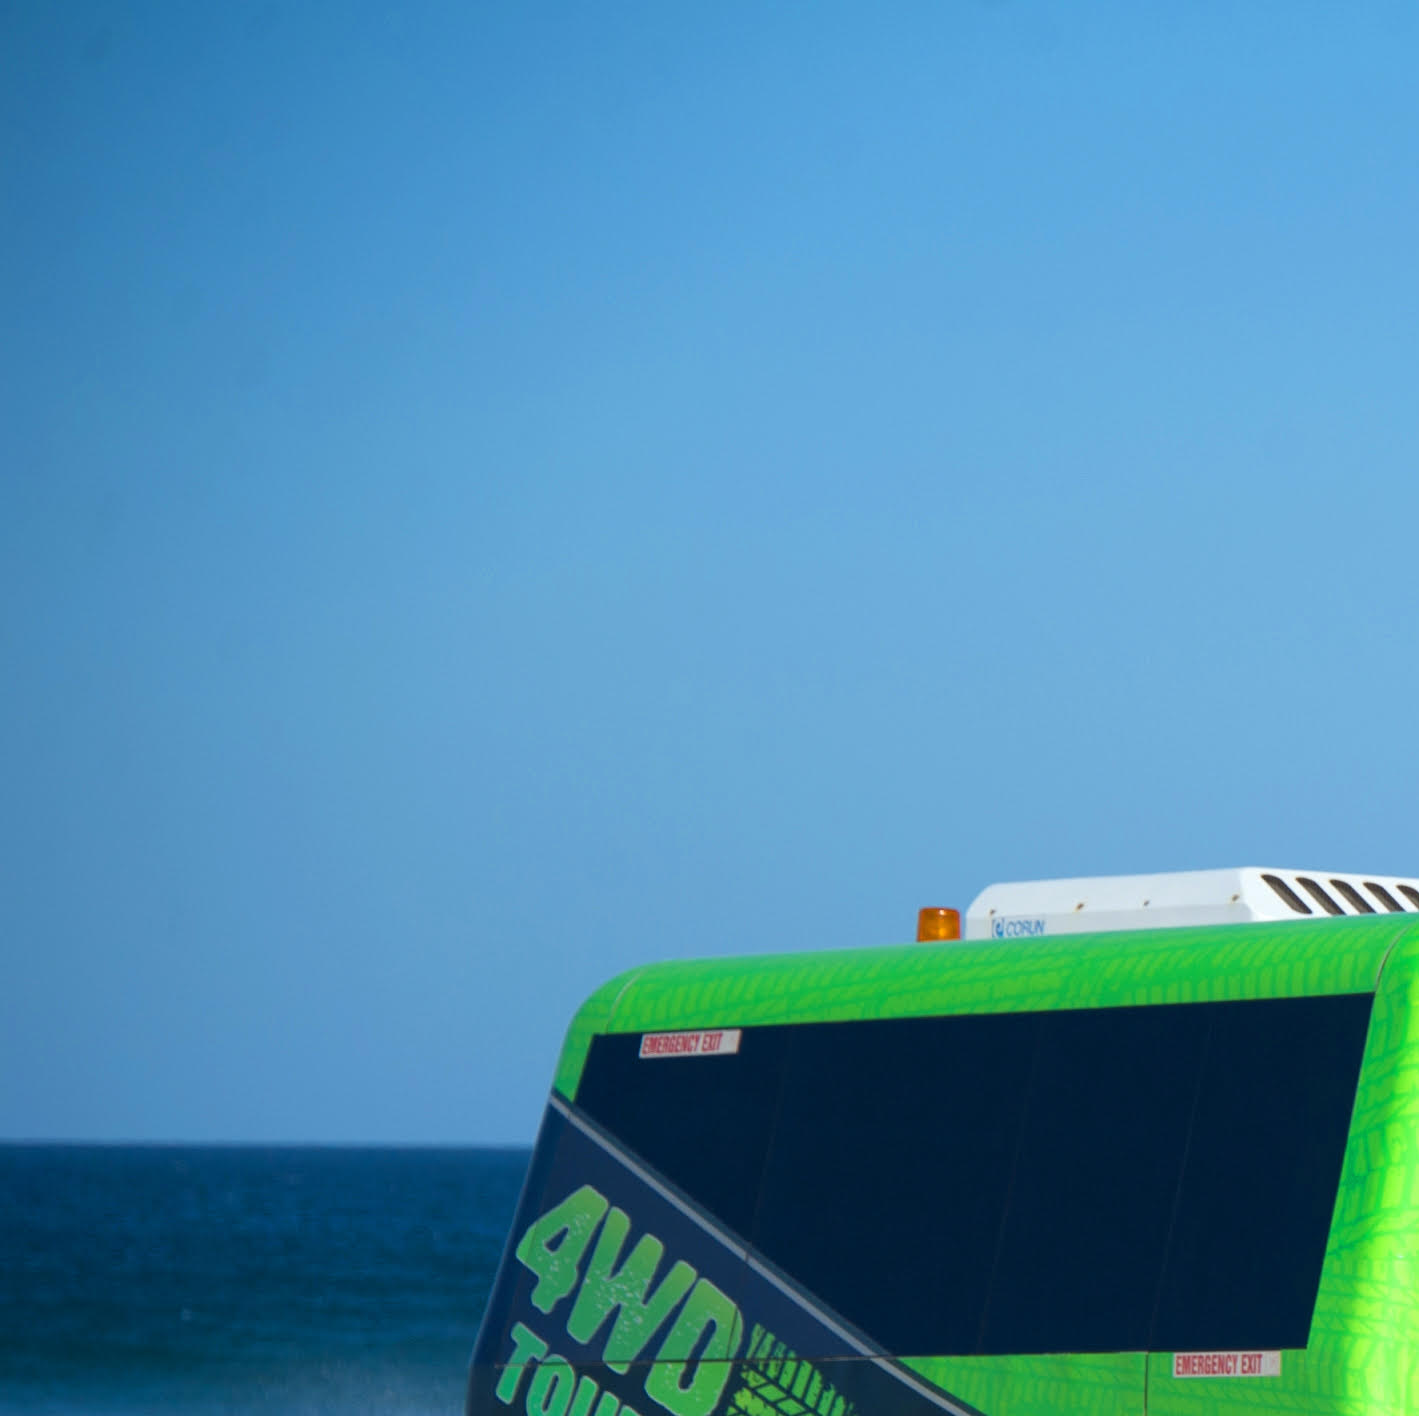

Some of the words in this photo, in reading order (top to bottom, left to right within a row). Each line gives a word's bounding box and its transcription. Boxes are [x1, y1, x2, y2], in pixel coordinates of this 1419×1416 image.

[642, 1034, 700, 1056] EMERGENCY
[702, 1032, 723, 1052] EXIT
[1175, 1354, 1238, 1375] EMERGENCY
[1240, 1353, 1263, 1374] EXIT
